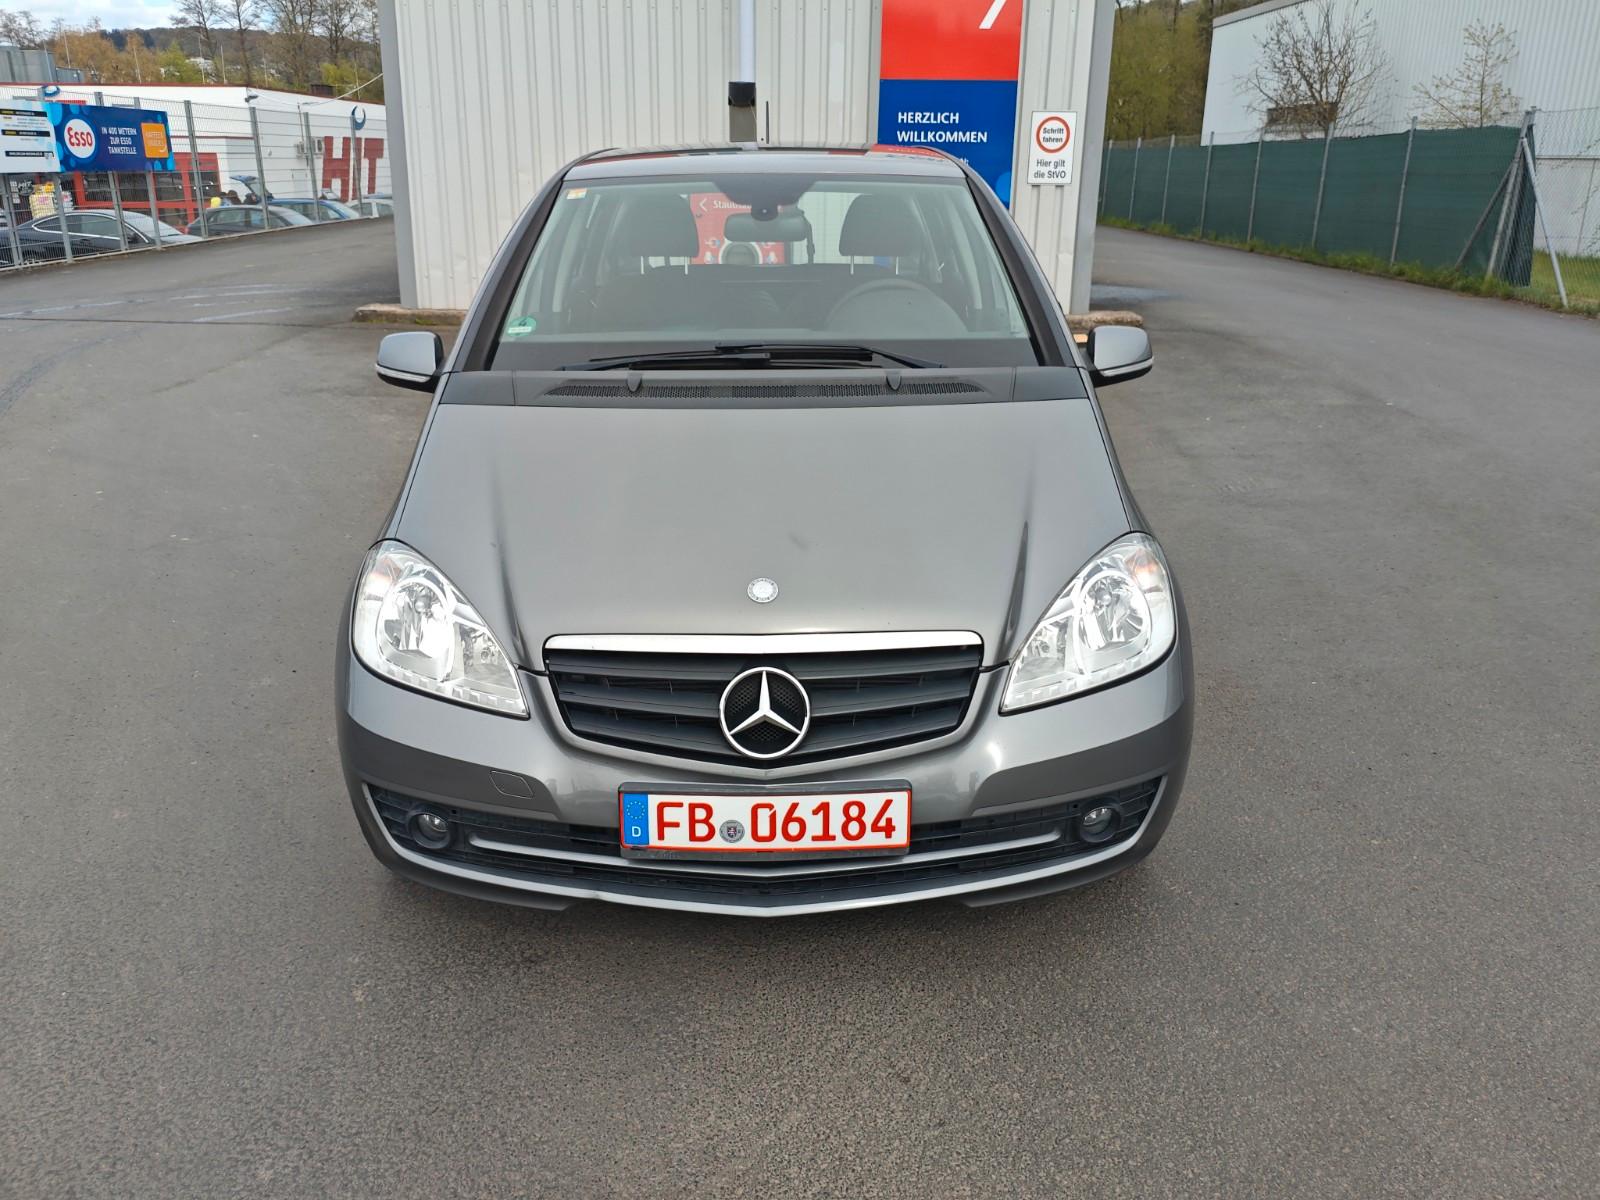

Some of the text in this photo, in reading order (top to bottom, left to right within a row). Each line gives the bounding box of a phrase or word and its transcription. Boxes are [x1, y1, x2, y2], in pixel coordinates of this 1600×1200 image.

[897, 111, 960, 124] HERZLICH
[101, 127, 108, 135] IN
[117, 127, 137, 135] METERN
[1042, 127, 1064, 135] Schritt
[109, 136, 132, 145] ZUR ESSO
[896, 130, 988, 143] WILLKOMMEN
[107, 146, 137, 155] TANKSTELLE
[1036, 159, 1065, 169] Hier gilt
[322, 136, 384, 203] HIT
[1033, 170, 1067, 179] die StVO
[656, 801, 717, 842] FB
[750, 799, 897, 843] 06184
[631, 825, 642, 837] D
